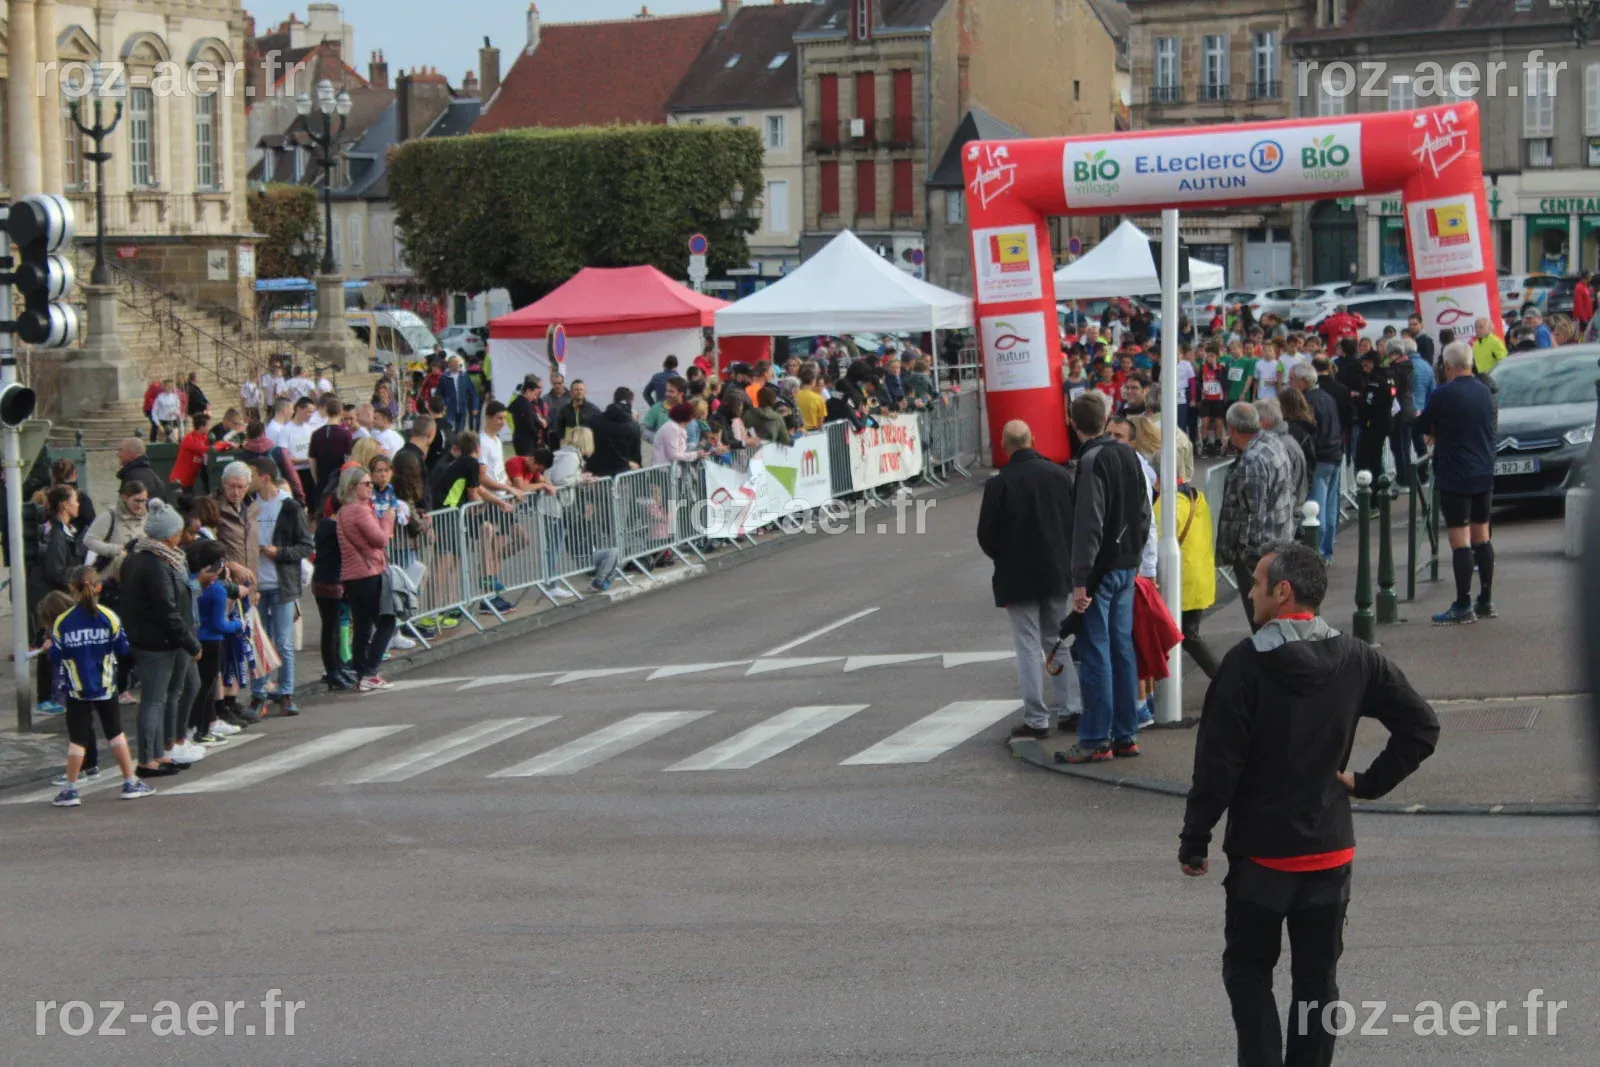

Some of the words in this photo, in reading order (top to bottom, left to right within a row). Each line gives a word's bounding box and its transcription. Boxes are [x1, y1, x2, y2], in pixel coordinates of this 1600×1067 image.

[1135, 152, 1246, 174] E.Leclerc
[1302, 167, 1350, 181] village
[1074, 181, 1120, 197] village
[1178, 175, 1246, 191] AUTUN
[996, 351, 1031, 363] autun
[64, 628, 110, 644] AUTUN
